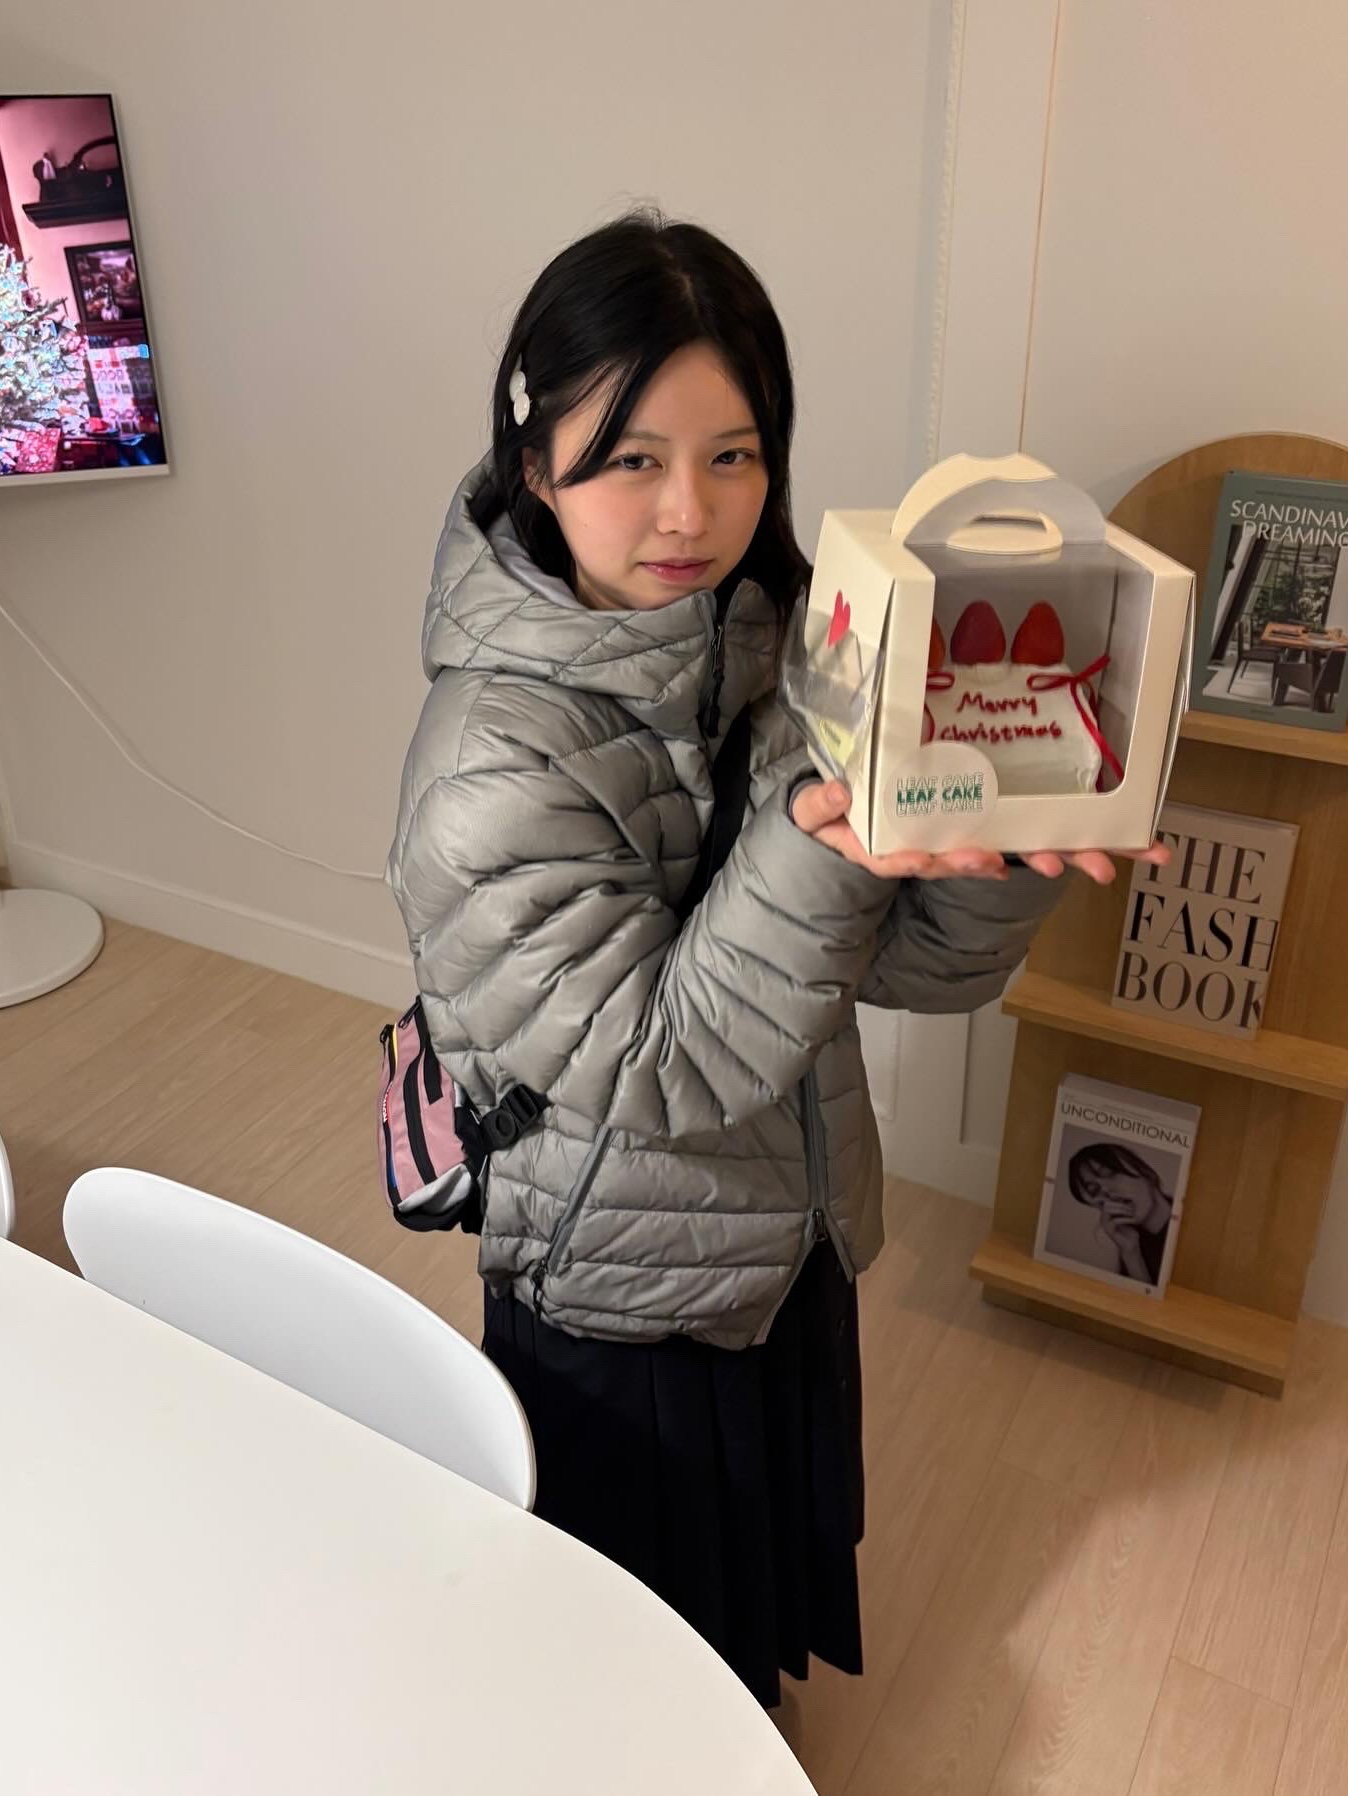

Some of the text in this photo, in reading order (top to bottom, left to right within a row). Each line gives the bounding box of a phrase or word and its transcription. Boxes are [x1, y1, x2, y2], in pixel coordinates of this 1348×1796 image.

[957, 692, 1037, 715] Merry
[897, 784, 983, 804] LEAF CAKE
[1061, 1102, 1189, 1148] UNCONDITIONAL
